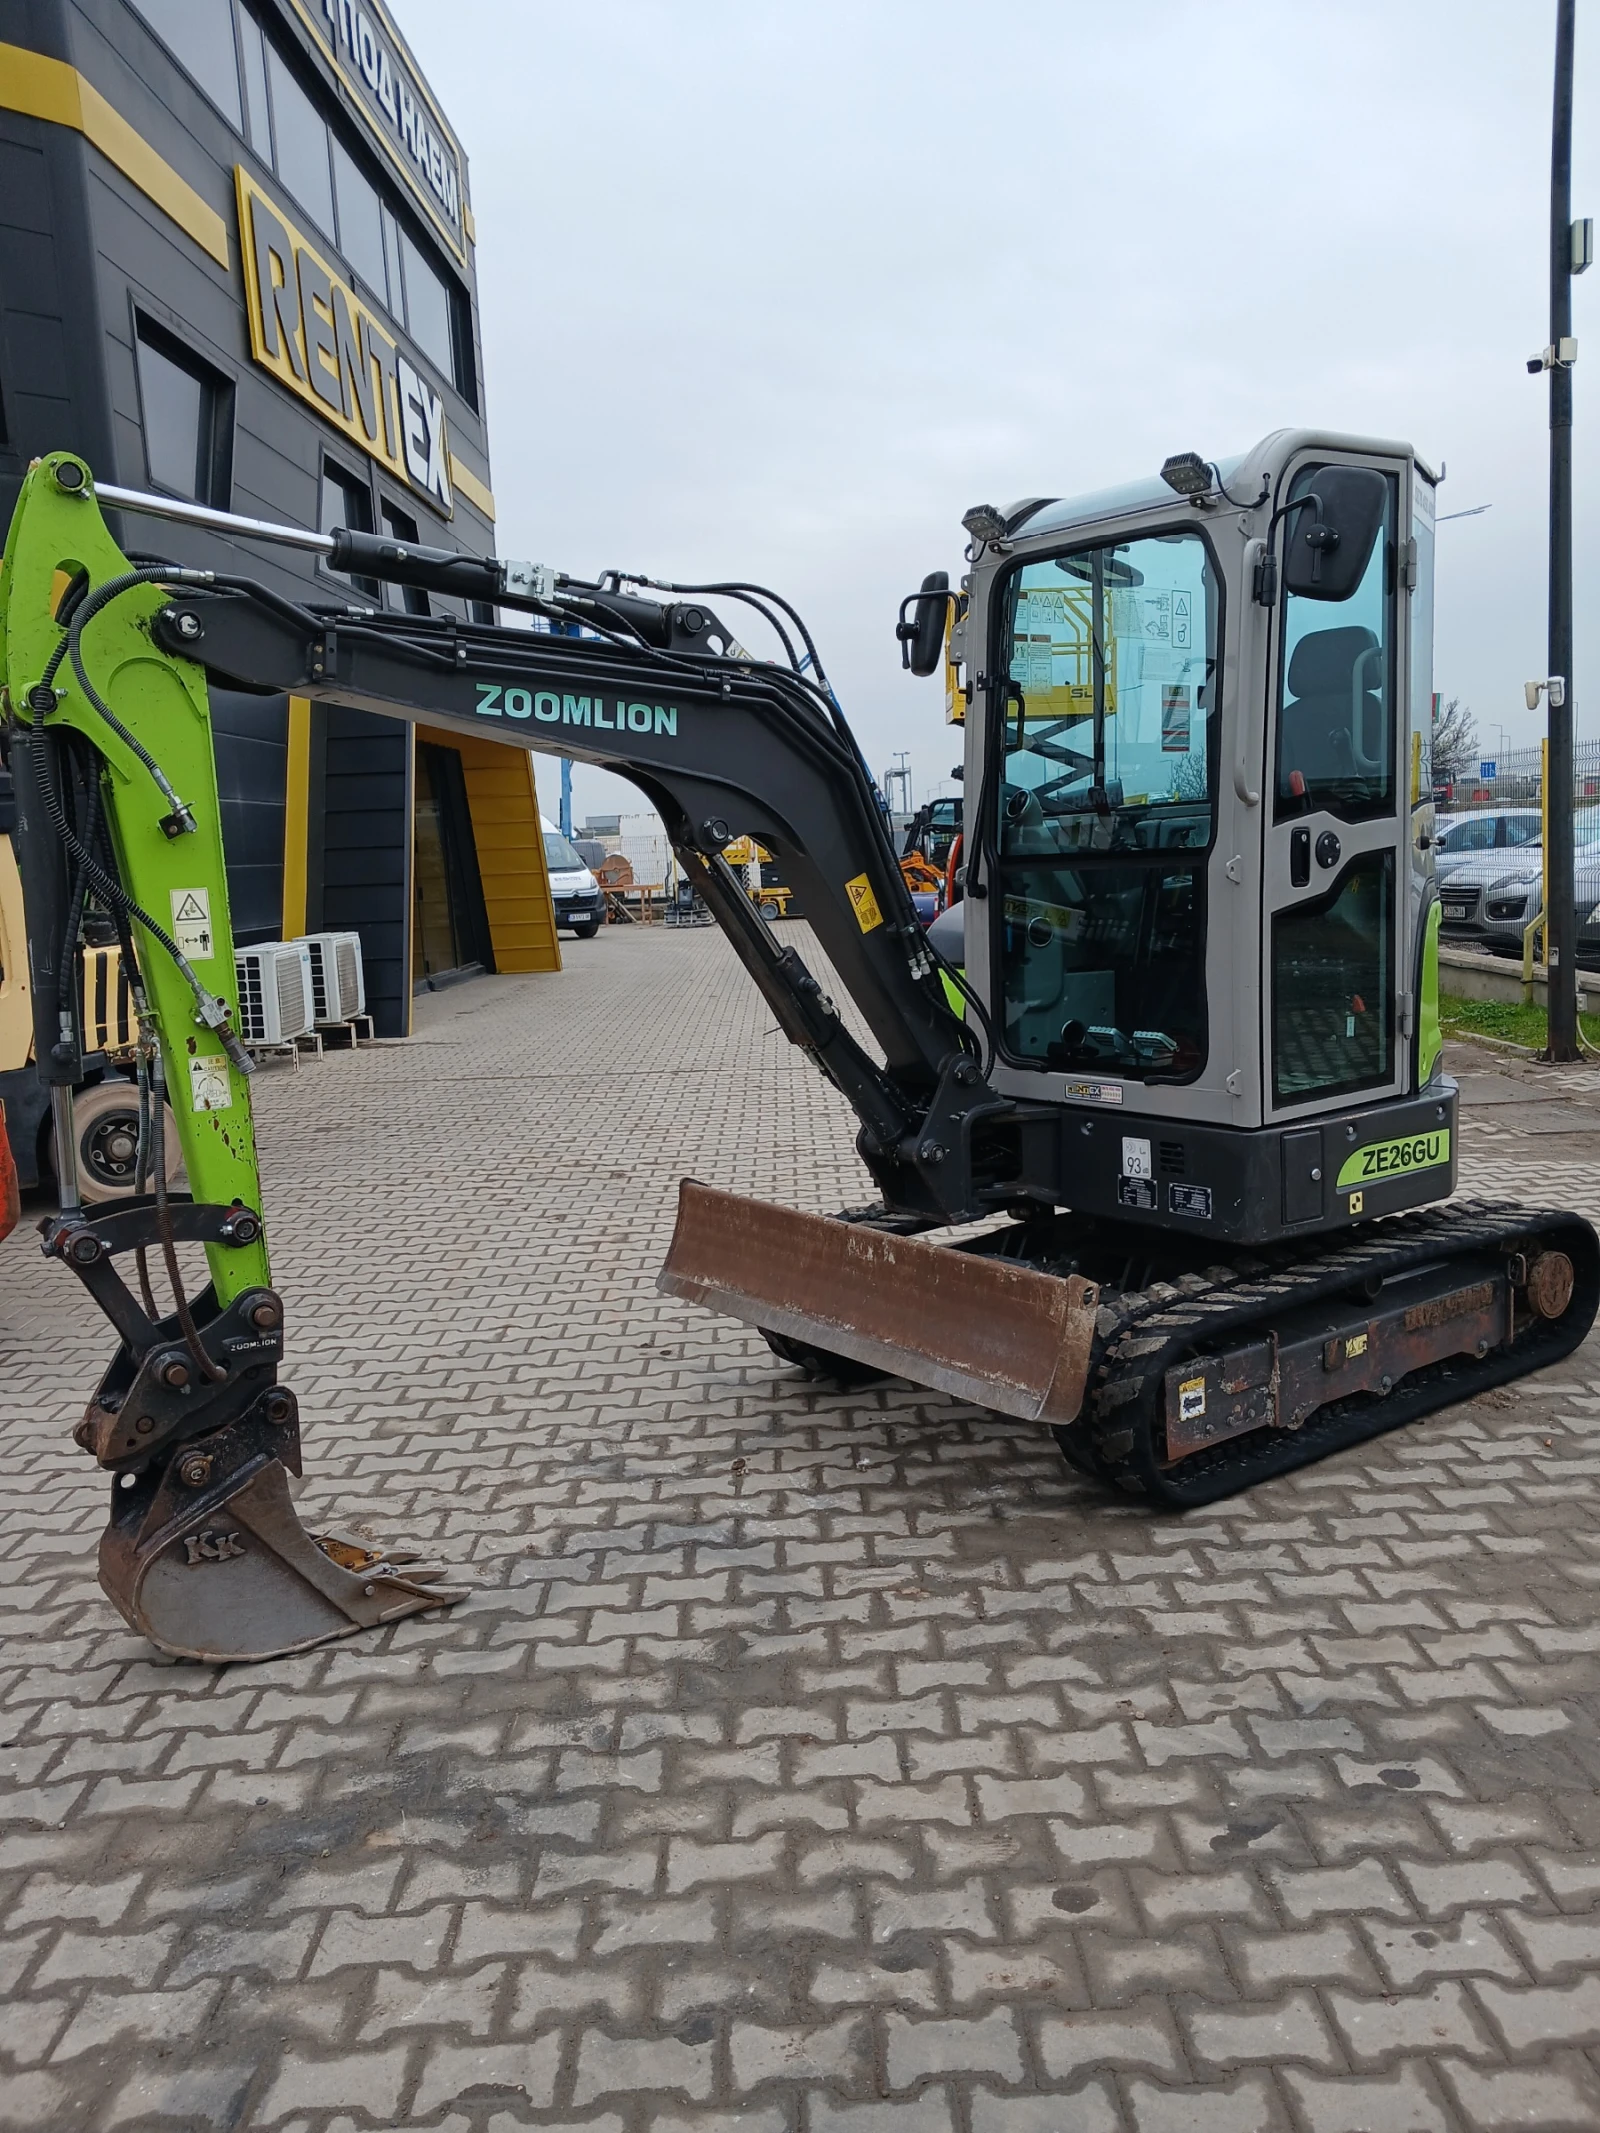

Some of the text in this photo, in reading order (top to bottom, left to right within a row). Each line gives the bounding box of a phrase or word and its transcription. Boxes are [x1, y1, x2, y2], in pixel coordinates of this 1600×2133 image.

[398, 78, 459, 225] НАЕМ
[250, 188, 452, 508] RENTEX
[475, 683, 678, 736] ZOOMLION
[1127, 1157, 1142, 1174] 93
[1362, 1136, 1440, 1176] ZE26GU
[230, 1338, 277, 1352] ZOOMLION
